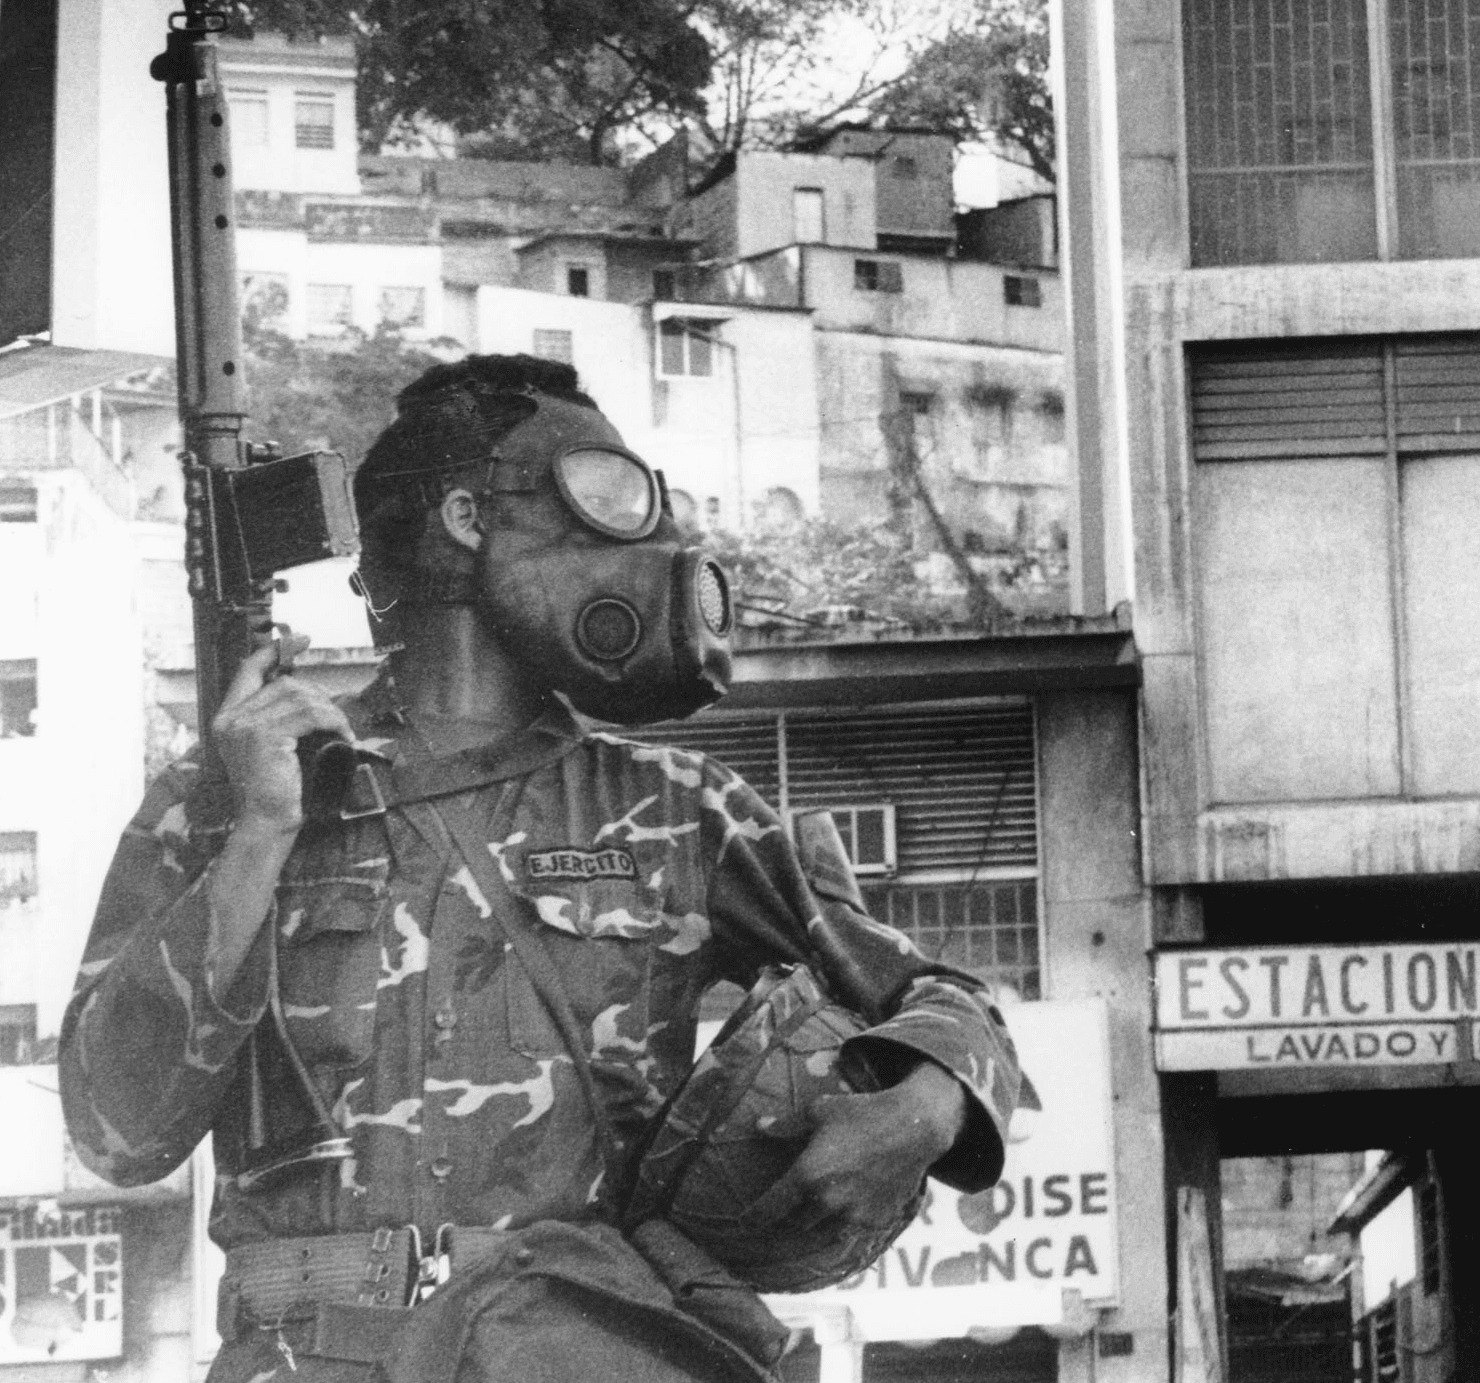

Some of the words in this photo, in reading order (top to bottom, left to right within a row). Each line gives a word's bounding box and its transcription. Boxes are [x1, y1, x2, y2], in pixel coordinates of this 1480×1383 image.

[531, 852, 631, 875] EJERCITO
[1246, 1030, 1417, 1062] LAVADO
[1428, 1030, 1448, 1056] Y
